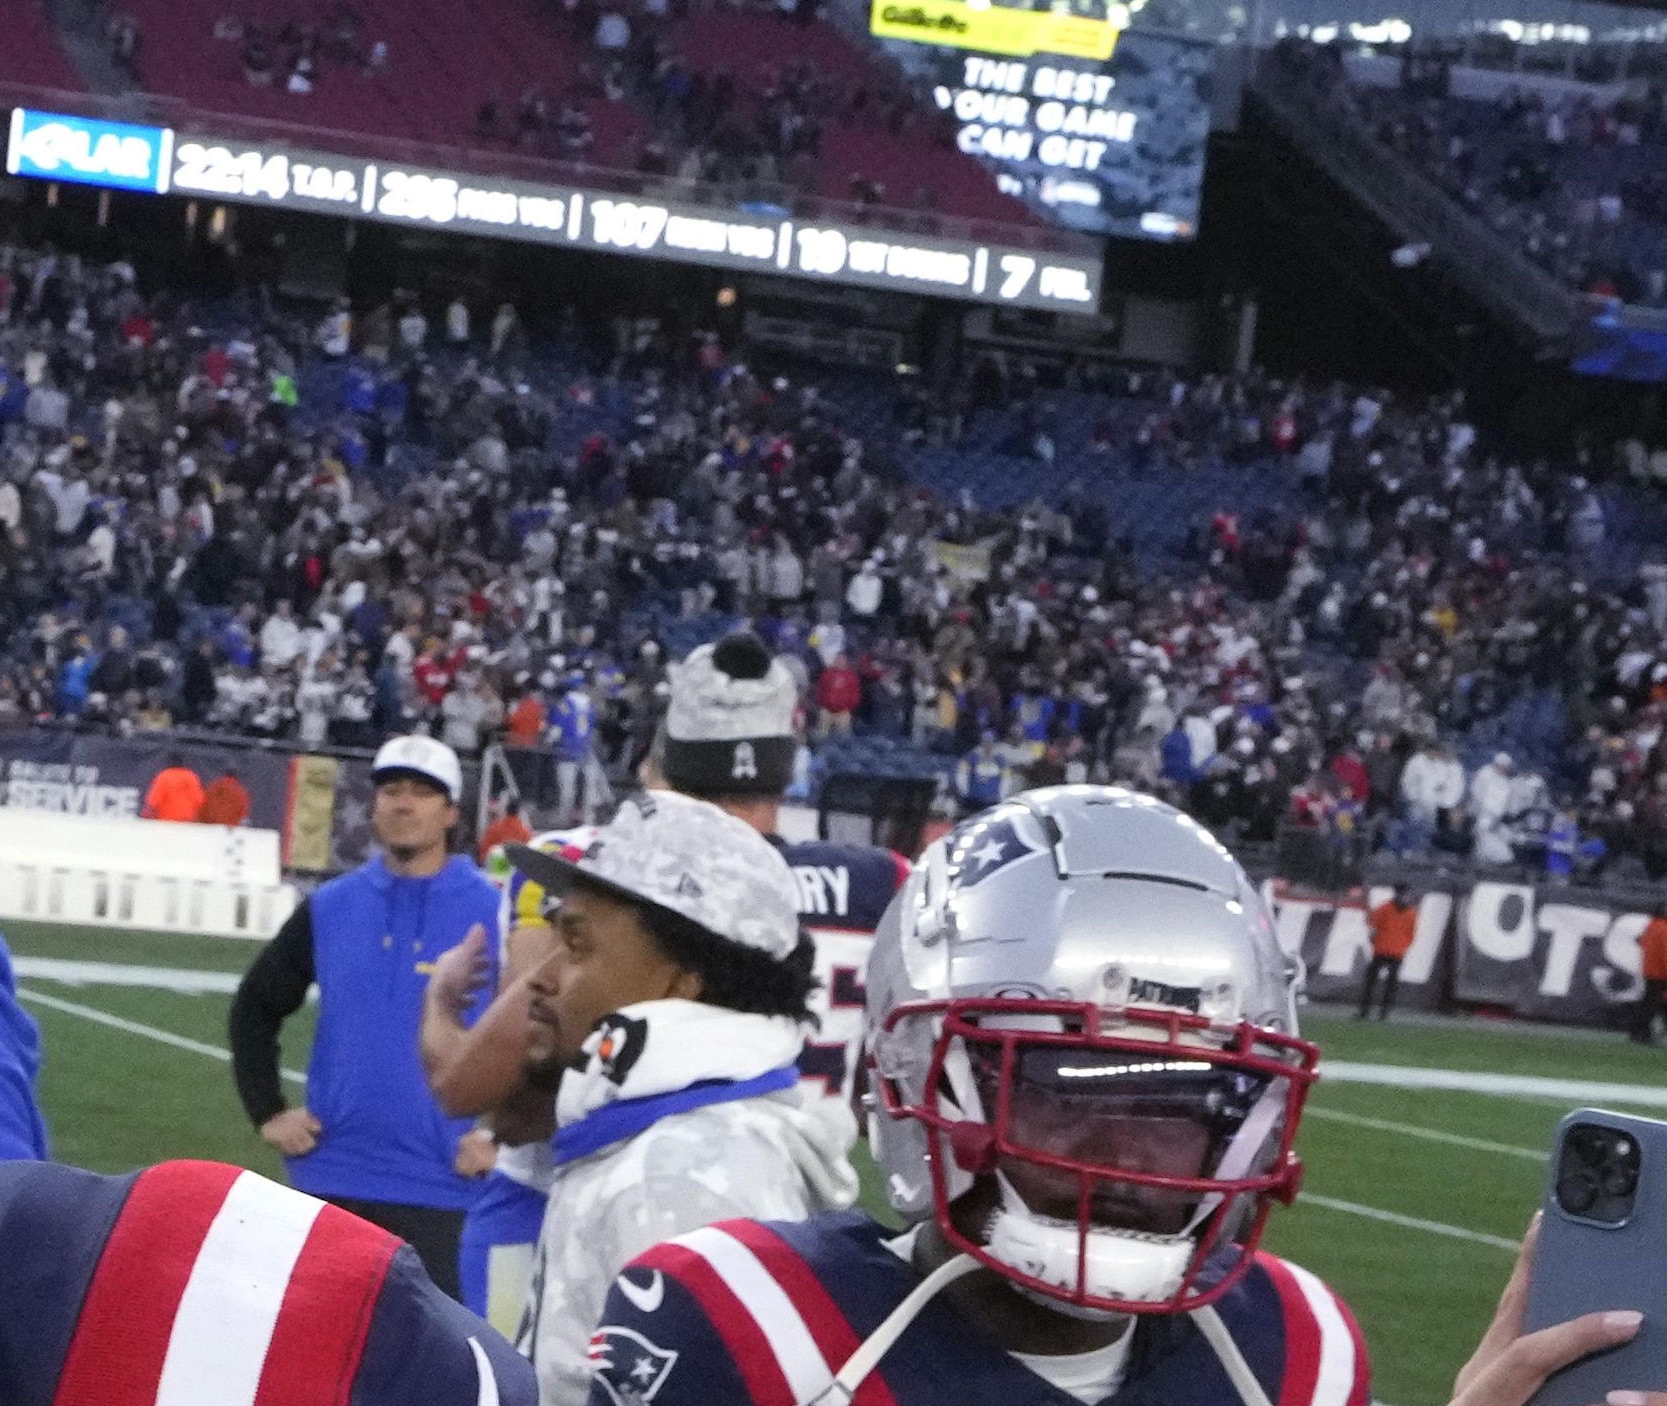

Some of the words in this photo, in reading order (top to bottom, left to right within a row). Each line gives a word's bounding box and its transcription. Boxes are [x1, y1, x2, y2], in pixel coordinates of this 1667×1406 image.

[964, 56, 1028, 93] THE
[1033, 66, 1115, 104] BEST
[1036, 100, 1138, 143] GAME
[957, 123, 1034, 162] CAN
[1038, 135, 1108, 172] GET
[592, 200, 667, 249] 107
[1001, 255, 1035, 299] 7
